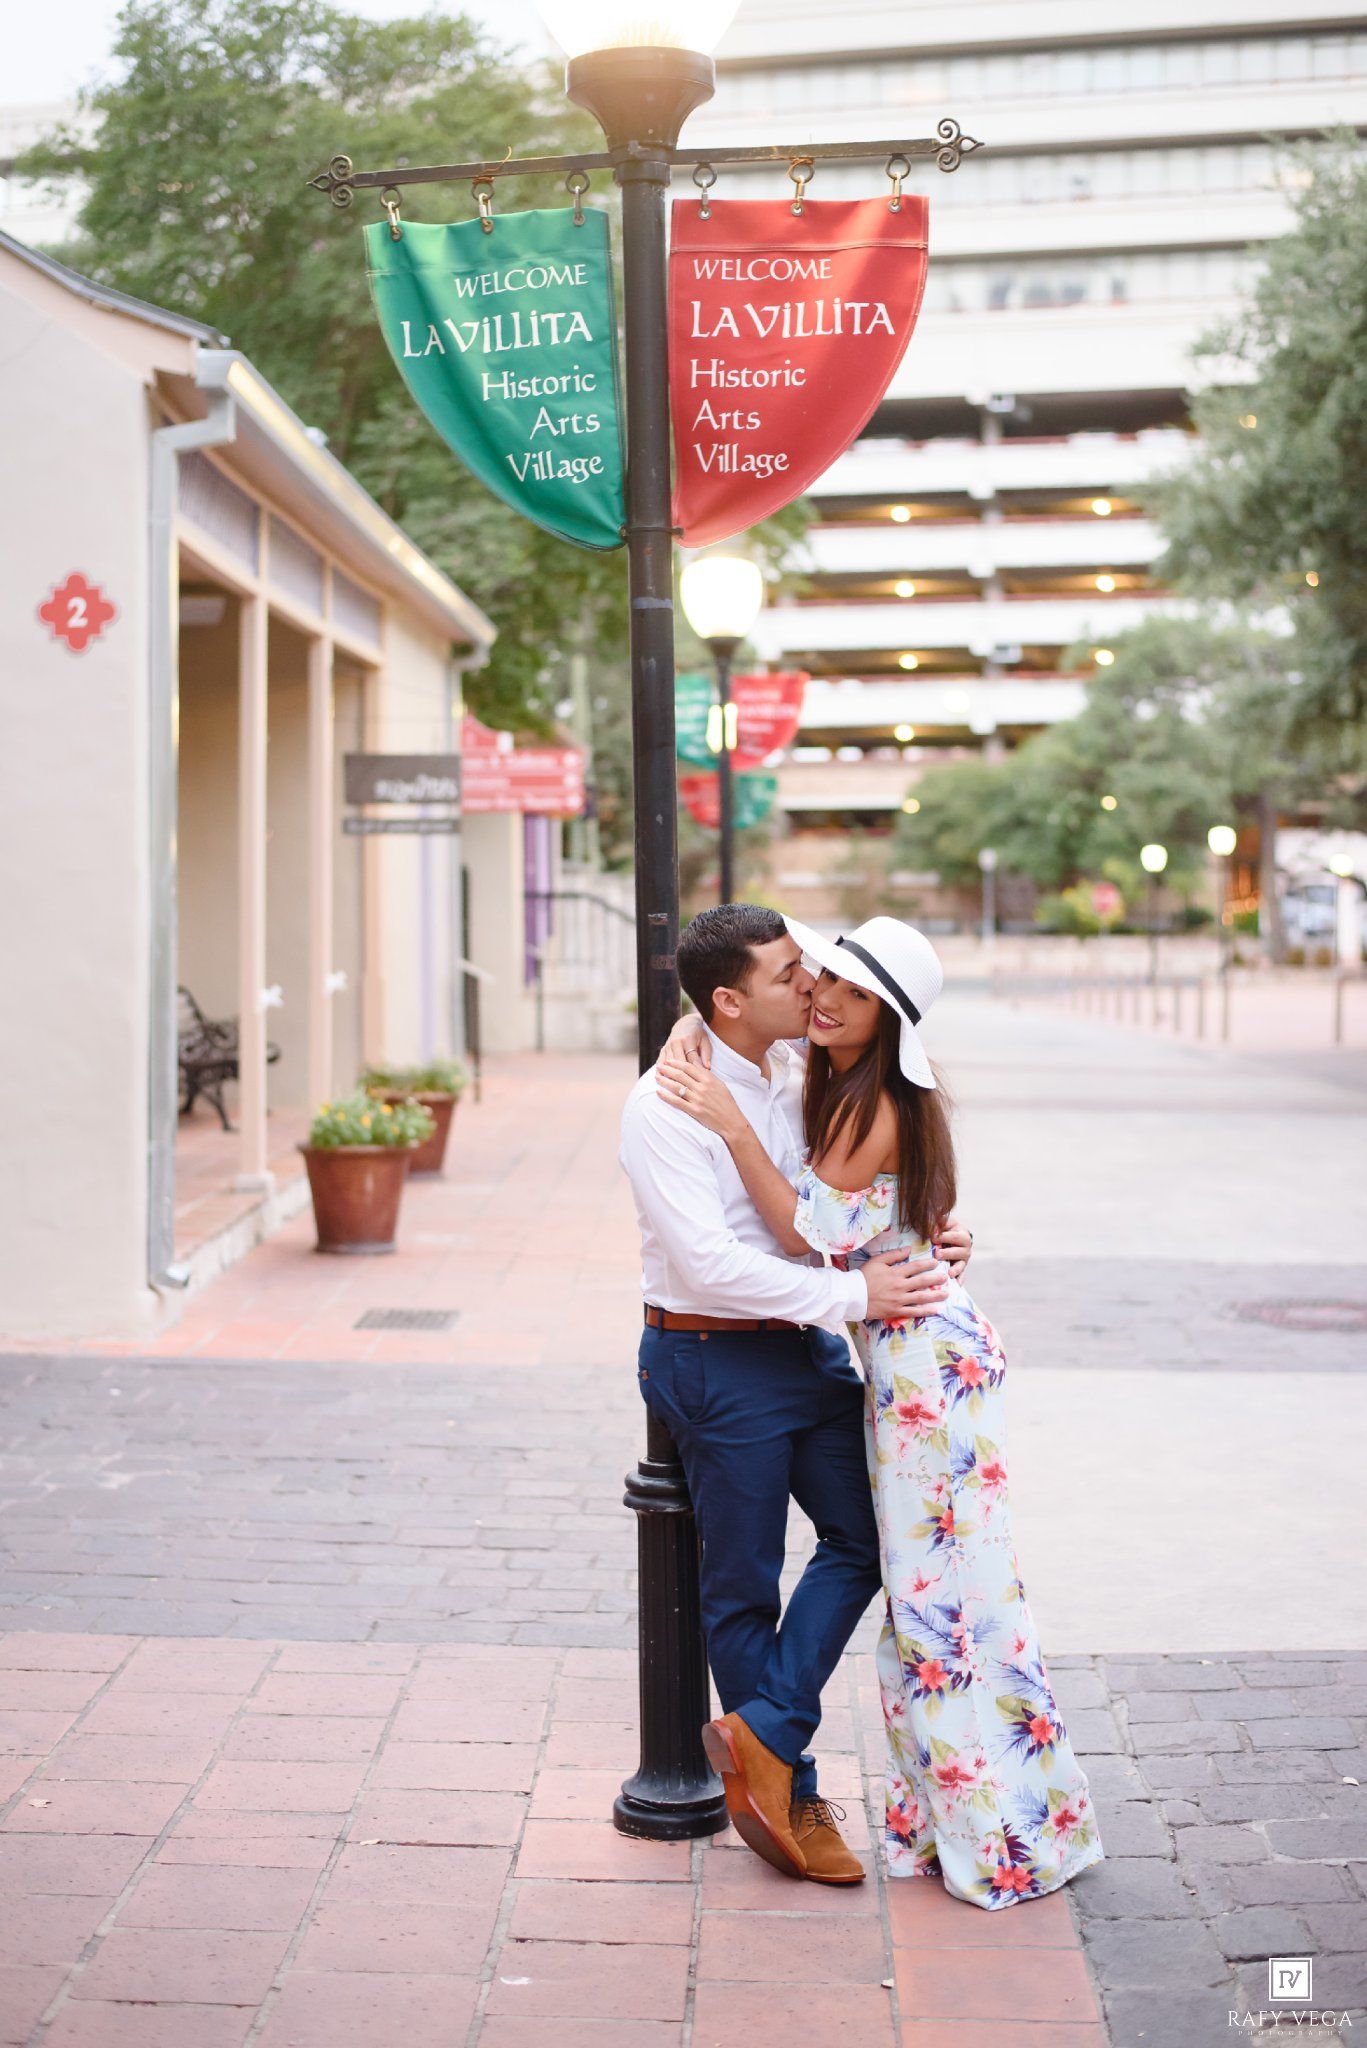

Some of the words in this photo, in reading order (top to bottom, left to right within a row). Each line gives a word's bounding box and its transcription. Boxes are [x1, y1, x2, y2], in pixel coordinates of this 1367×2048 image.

[454, 264, 589, 299] WELCOME
[692, 258, 833, 282] WELCOME
[690, 300, 741, 338] LA
[400, 320, 446, 358] LA
[480, 364, 597, 402] Historic
[690, 358, 807, 389] Historic
[529, 406, 601, 441] Arts
[691, 398, 762, 432] Arts
[505, 449, 605, 484] Village
[693, 442, 790, 479] Village
[66, 595, 89, 629] 2
